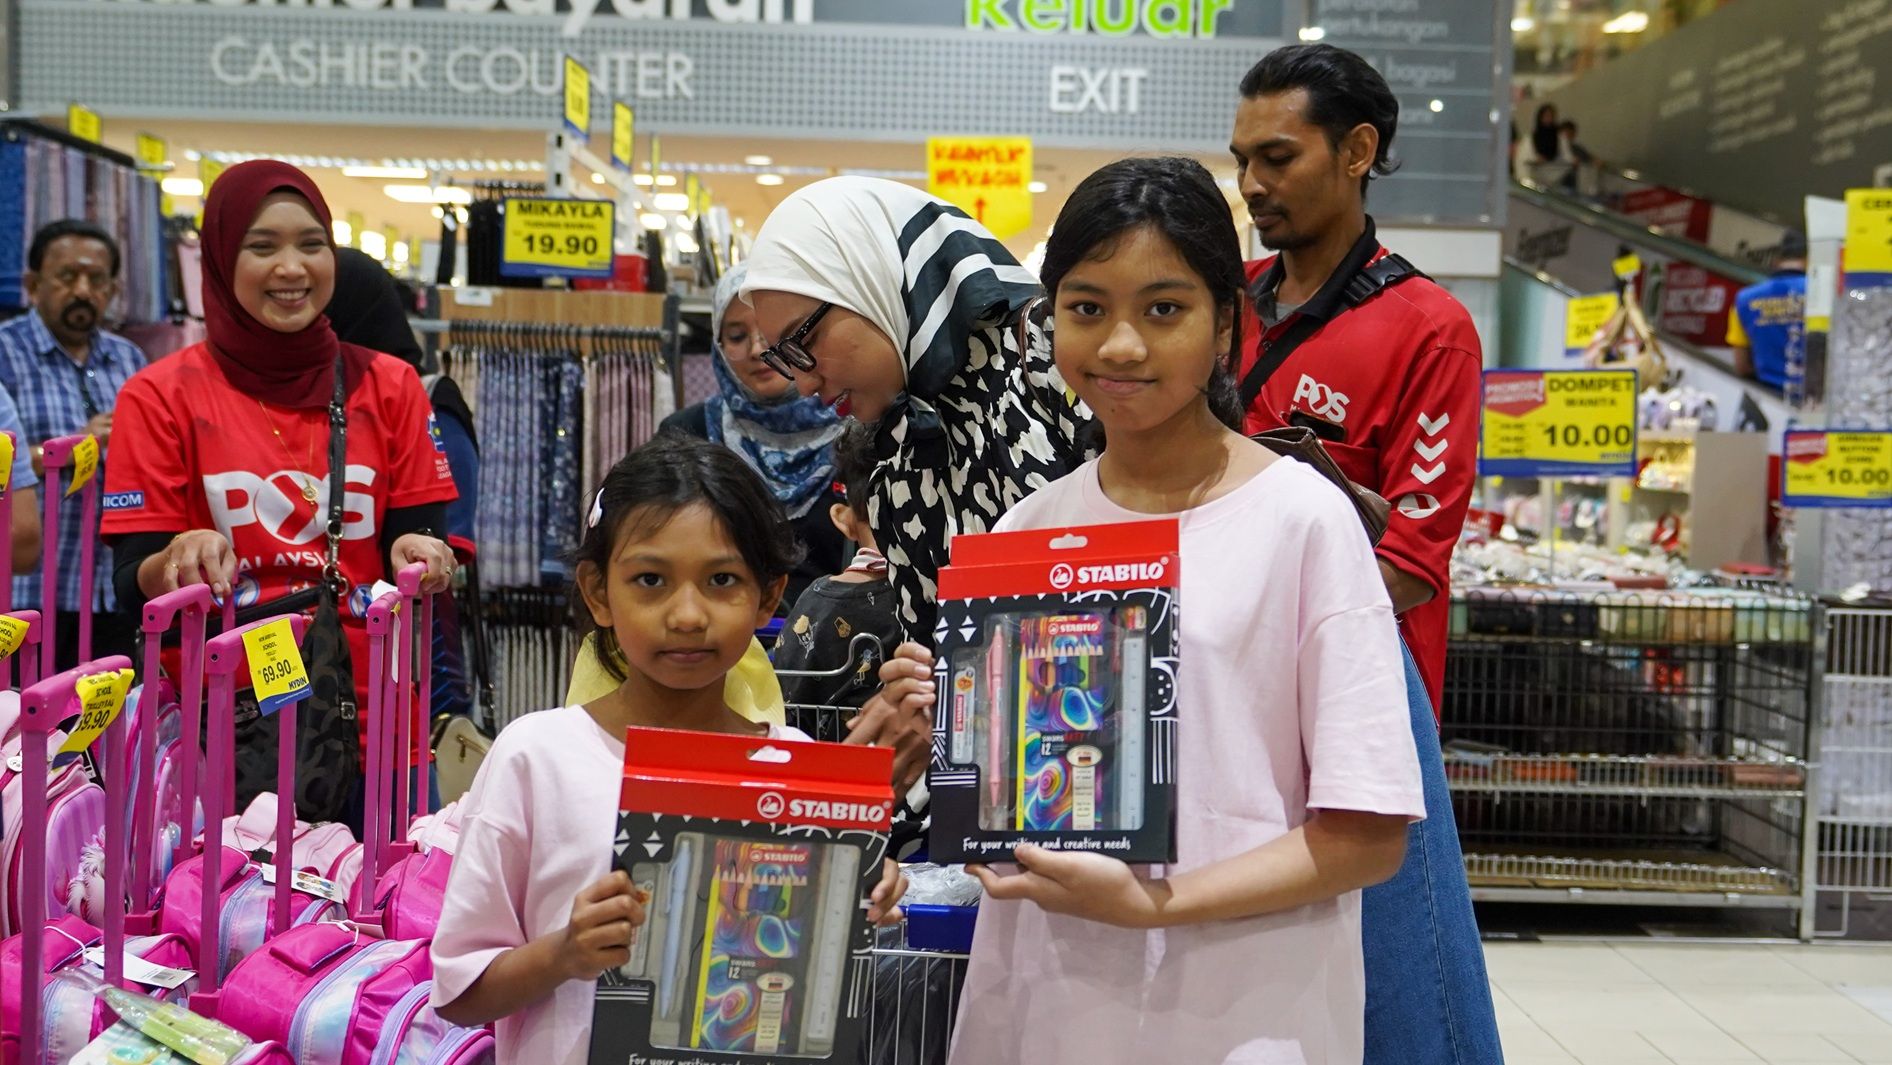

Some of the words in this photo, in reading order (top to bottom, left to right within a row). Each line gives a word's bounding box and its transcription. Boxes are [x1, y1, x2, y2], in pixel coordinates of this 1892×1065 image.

[212, 36, 428, 90] CASHIER
[1050, 65, 1148, 114] EXIT
[518, 203, 604, 218] MIKAYLA
[523, 234, 598, 255] 19.90
[1549, 378, 1634, 393] DOMPET
[1293, 373, 1350, 422] POS
[1544, 425, 1632, 447] 10.00
[1827, 468, 1890, 485] 10.00
[103, 494, 142, 507] ICOM
[203, 464, 377, 548] POS
[1077, 561, 1164, 584] STABILO
[262, 659, 292, 684] 69.90
[288, 676, 307, 690] MYDIN
[1041, 742, 1052, 755] 12
[789, 798, 885, 823] STABILO
[963, 837, 979, 851] For
[980, 839, 1003, 854] your
[1041, 837, 1061, 850] and
[1064, 836, 1101, 850] creative
[1103, 836, 1131, 850] needs
[728, 966, 740, 979] 12
